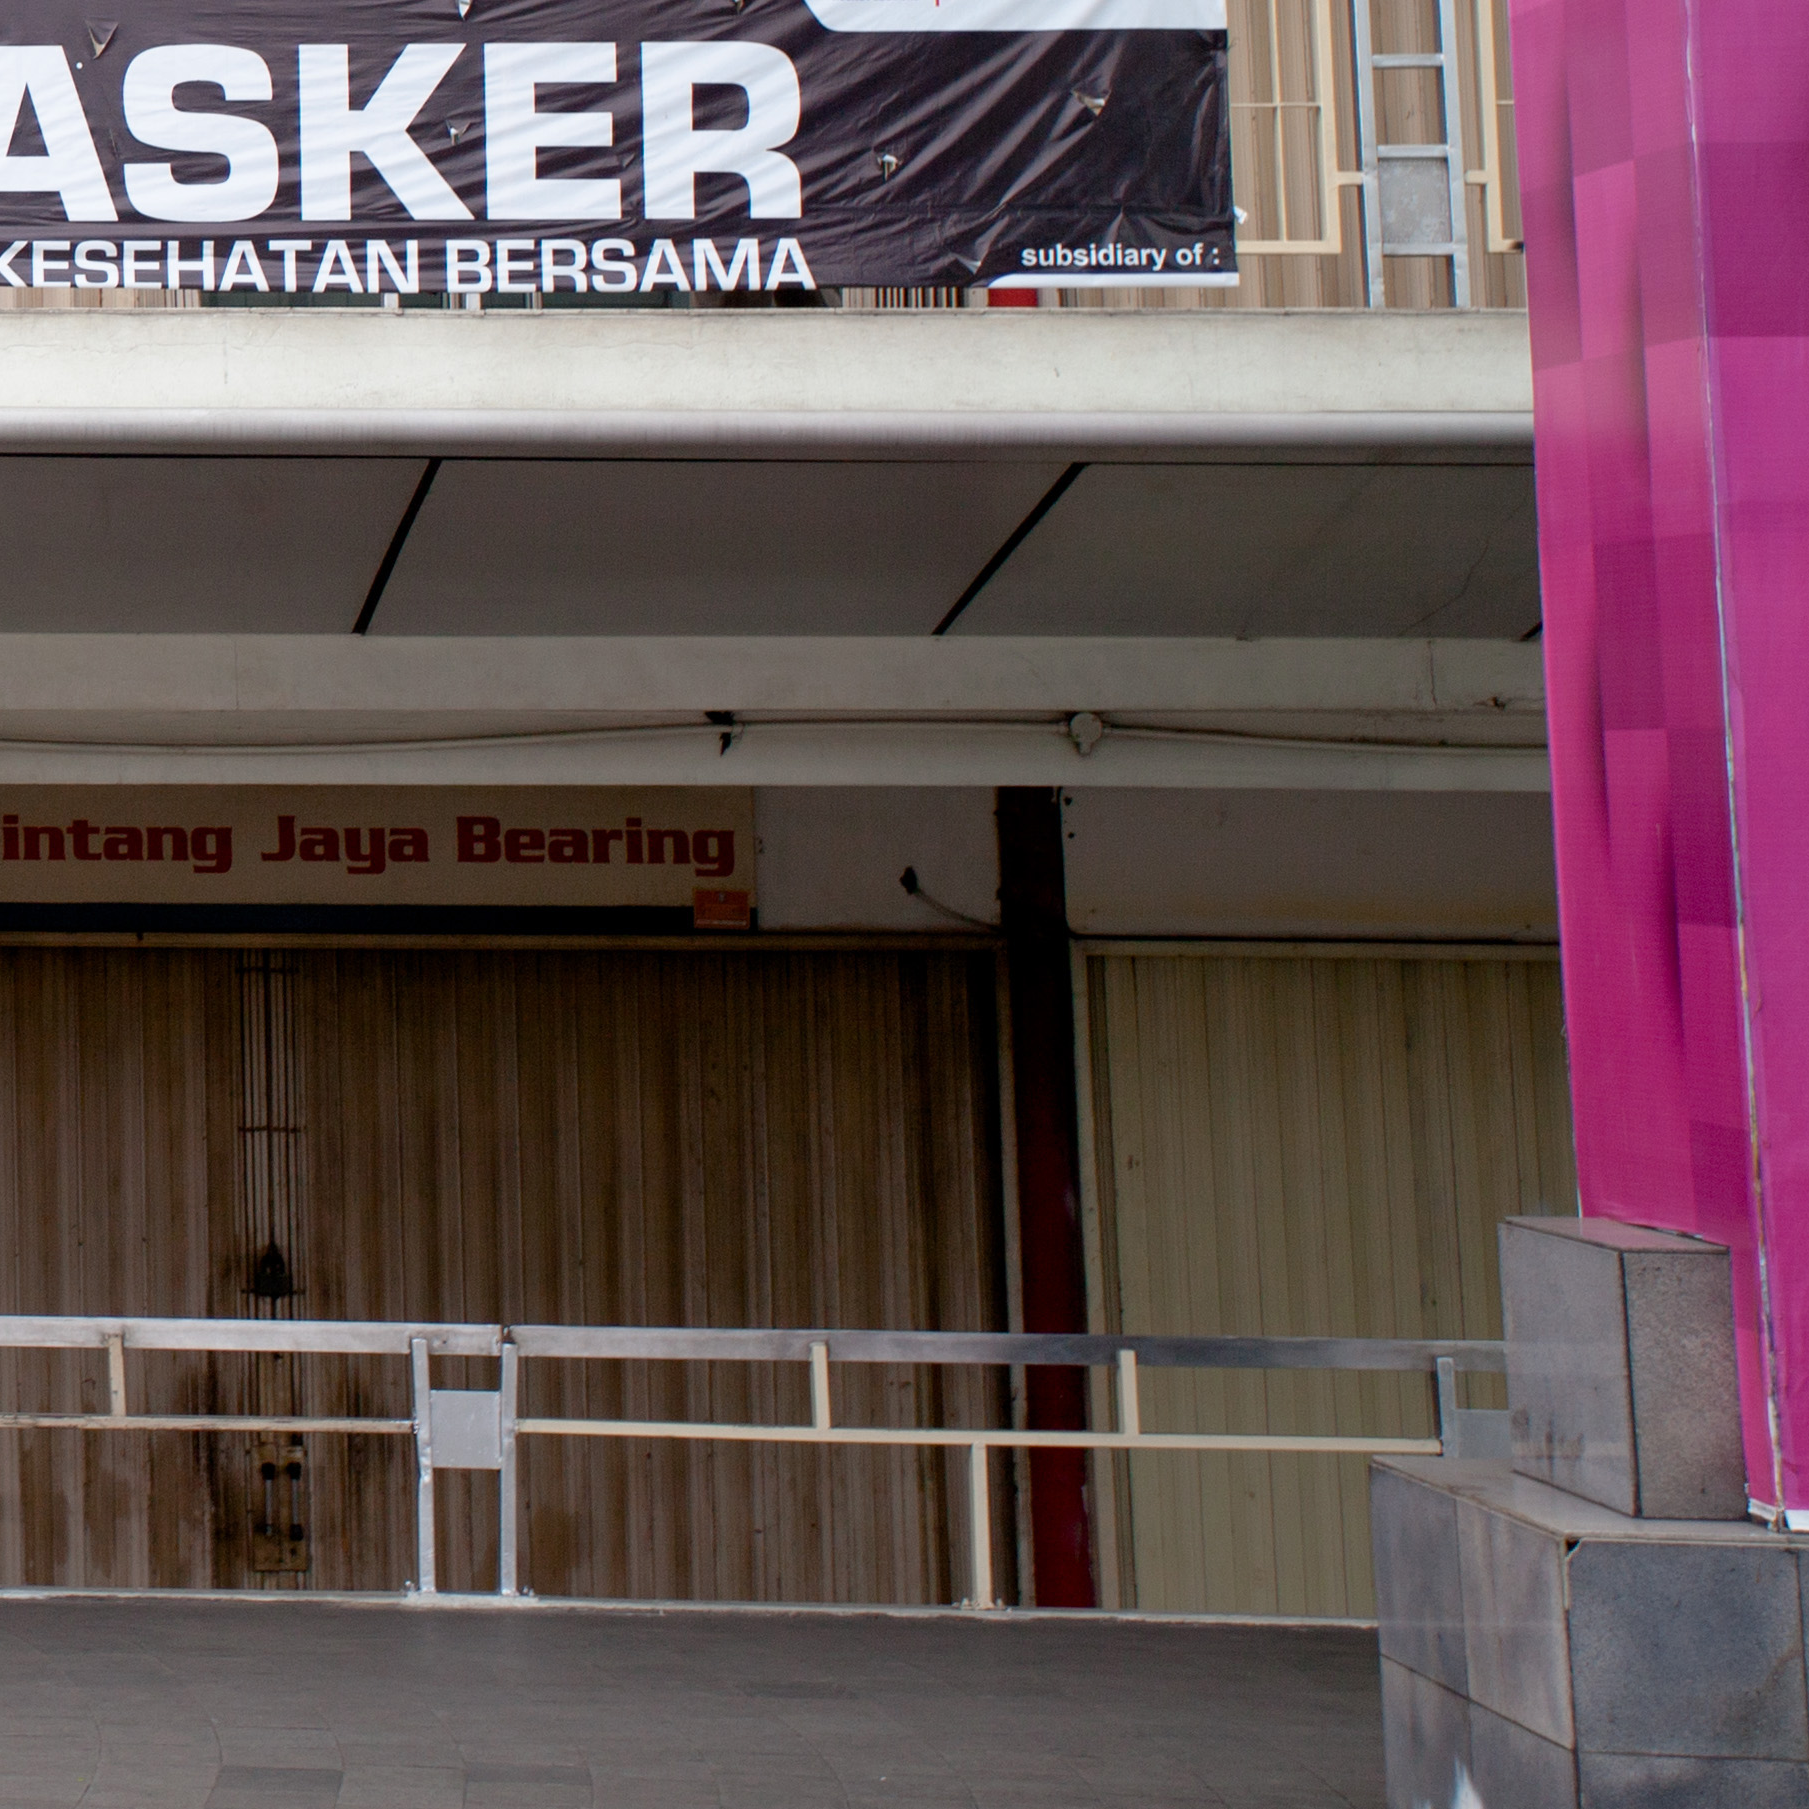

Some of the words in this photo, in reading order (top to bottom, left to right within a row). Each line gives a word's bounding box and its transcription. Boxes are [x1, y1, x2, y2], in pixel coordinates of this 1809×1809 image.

[445, 238, 817, 294] BERSAMA
[1020, 242, 1168, 271] subsidiary
[1174, 241, 1205, 266] of
[261, 815, 430, 875] Jaya
[456, 816, 736, 877] Bearing
